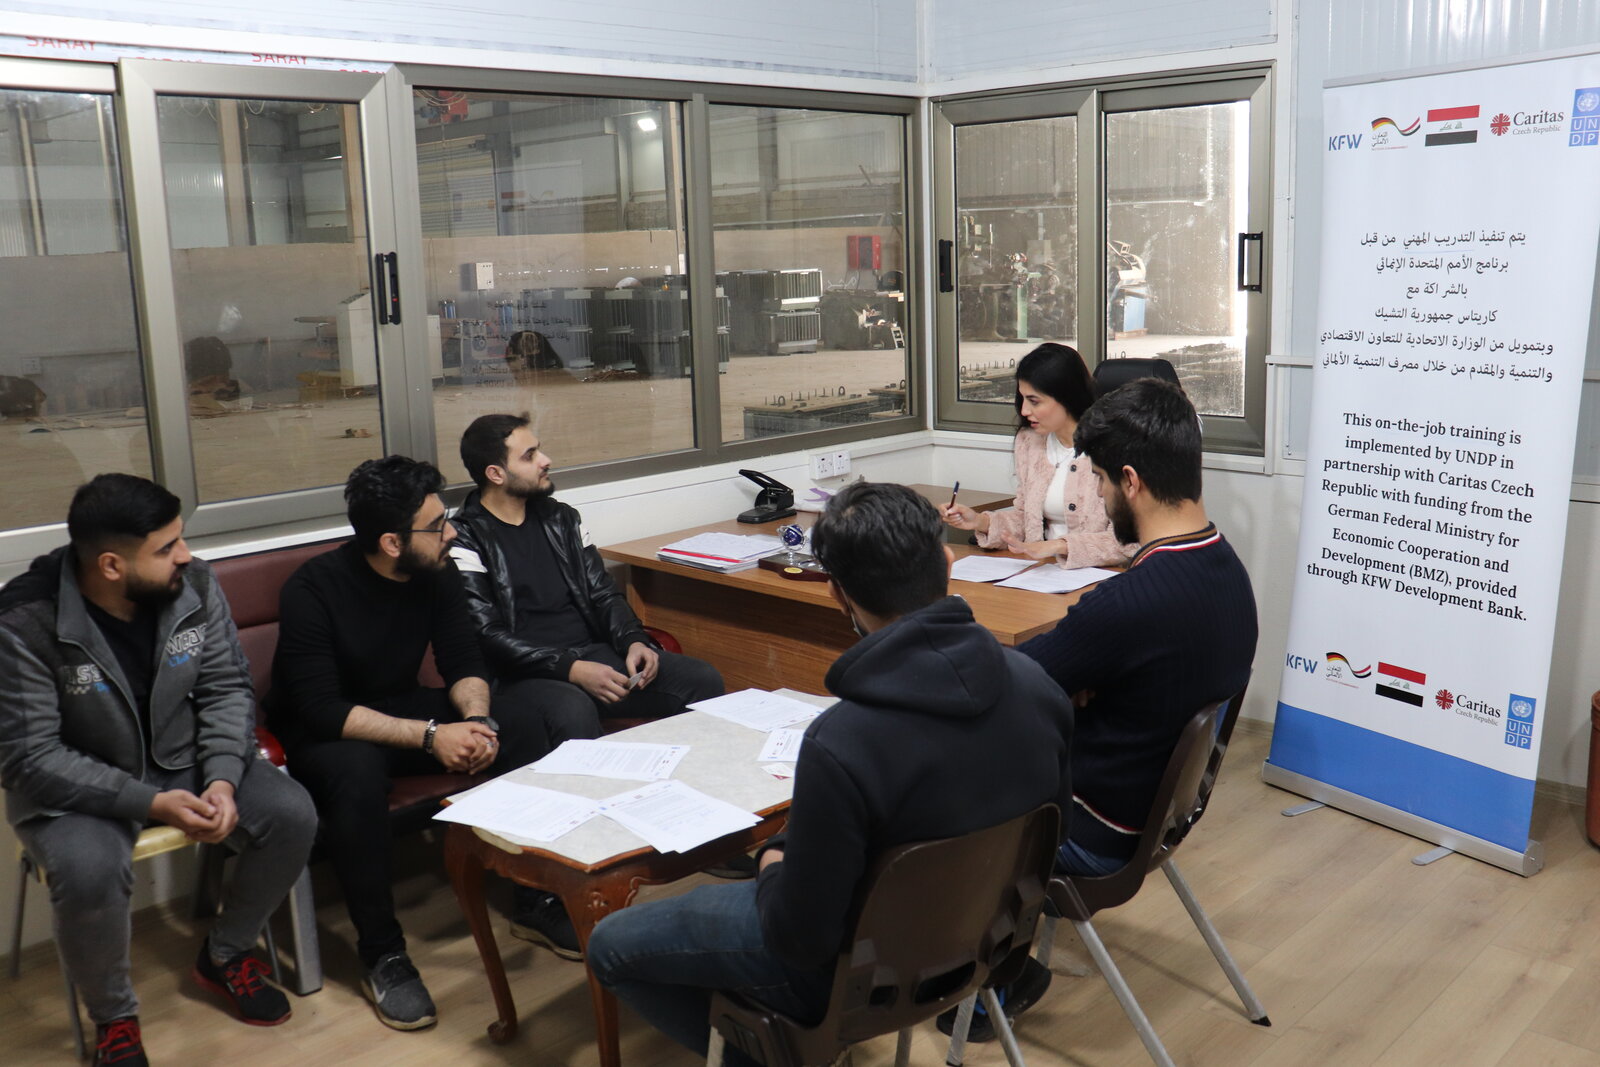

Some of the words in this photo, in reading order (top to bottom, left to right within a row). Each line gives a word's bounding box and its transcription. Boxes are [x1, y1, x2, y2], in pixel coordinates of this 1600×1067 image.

[1513, 110, 1564, 126] Caritas
[1512, 127, 1531, 135] Czech
[1532, 125, 1561, 134] Republic
[1328, 133, 1363, 151] KFW
[1360, 233, 1377, 246] قبل
[1382, 235, 1396, 246] من
[1403, 233, 1429, 249] المهني
[1434, 231, 1475, 246] التدريب
[1479, 230, 1505, 246] تنفيذ
[1509, 233, 1526, 248] يتم
[1376, 258, 1405, 274] الإنمائي
[1409, 258, 1443, 270] المتحدة
[1447, 254, 1472, 274] الأمم
[1476, 259, 1508, 274] برنامج
[1406, 286, 1419, 299] مع
[1375, 307, 1406, 321] التشيك
[1411, 308, 1453, 323] جمهورية
[1458, 310, 1497, 325] كاريتاس
[1320, 330, 1364, 345] الاقتصادي
[1367, 333, 1402, 345] للتعاون
[1406, 335, 1448, 346] الاتحادية
[1452, 337, 1485, 351] الوزارة
[1489, 340, 1504, 351] من
[1323, 352, 1349, 369] الألماني
[1353, 357, 1384, 370] التنمية
[1388, 358, 1419, 372] مصرف
[1423, 360, 1447, 372] خلال
[1451, 363, 1465, 376] من
[1469, 365, 1505, 380] والمقدم
[1509, 366, 1552, 382] والتنمية
[1343, 413, 1372, 427] This
[1375, 417, 1446, 437] on-the-job
[1450, 425, 1506, 446] training
[1510, 430, 1521, 444] is
[1345, 437, 1431, 458] implemented
[1435, 447, 1451, 463] by
[1456, 450, 1497, 467] UNDP
[1501, 455, 1514, 469] in
[1324, 458, 1401, 480] partnership
[1404, 468, 1434, 482] with
[1439, 472, 1487, 490] Caritas
[1491, 480, 1534, 497] Czech
[1322, 479, 1378, 498] Republic
[1382, 489, 1410, 503] with
[1414, 492, 1468, 516] funding
[1471, 502, 1503, 518] from
[1508, 508, 1532, 523] the
[1328, 504, 1379, 522] German
[1383, 512, 1431, 532] Federal
[1436, 521, 1495, 546] Ministry
[1499, 532, 1520, 548] for
[1333, 528, 1394, 550] Economic
[1398, 540, 1480, 567] Cooperation
[1484, 558, 1509, 573] and
[1322, 548, 1405, 575] Development
[1409, 564, 1452, 586] (BMZ),
[1456, 575, 1517, 598] provided
[1307, 564, 1357, 585] through
[1362, 574, 1391, 589] KFW
[1395, 581, 1483, 611] Development
[1487, 601, 1526, 620] Bank.
[1286, 653, 1318, 674] KFW
[1456, 694, 1501, 718] Caritas
[1455, 708, 1473, 718] Czech
[1474, 714, 1499, 726] Republic
